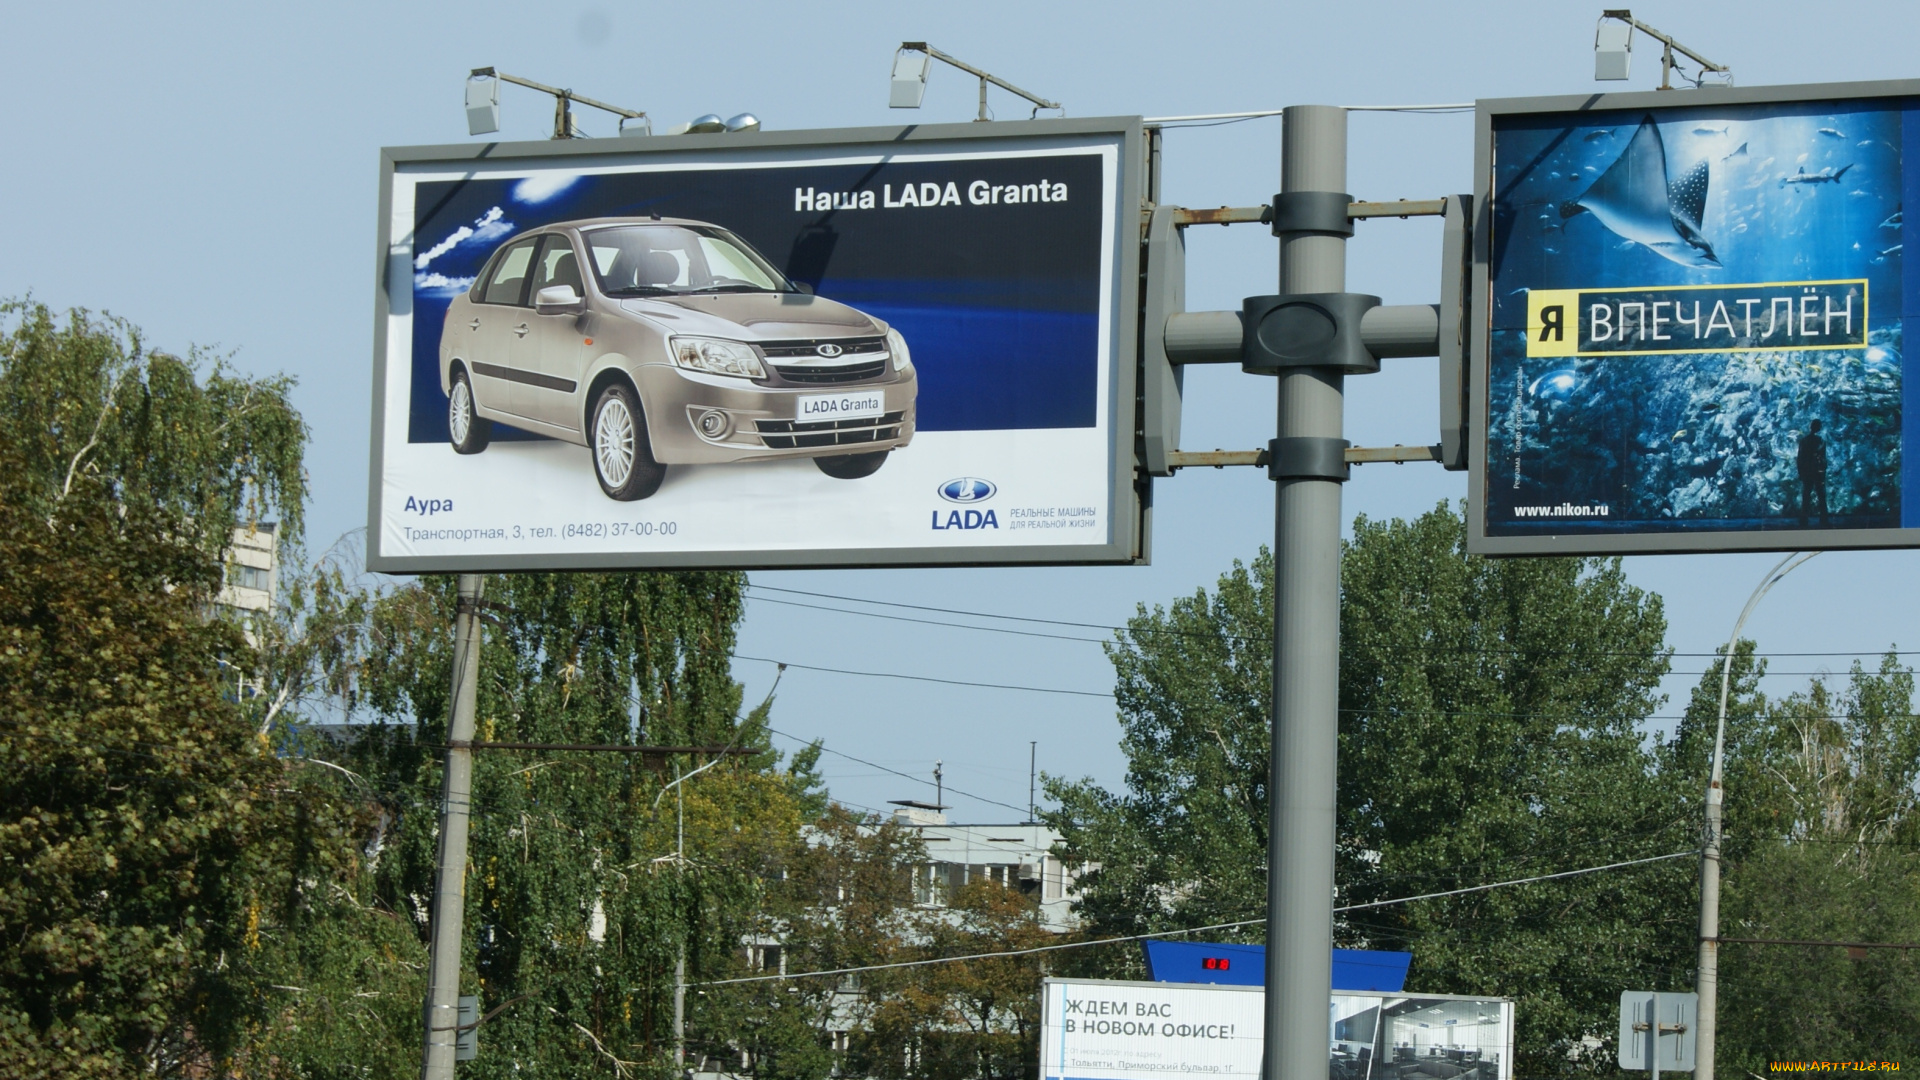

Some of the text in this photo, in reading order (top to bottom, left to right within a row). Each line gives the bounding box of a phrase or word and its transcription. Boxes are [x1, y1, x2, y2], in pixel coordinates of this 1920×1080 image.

[795, 179, 1068, 211] Наша LADA Granta
[1538, 287, 1851, 342] Я ВПЕЧАТЛЁН
[804, 398, 879, 414] LADA Granta
[404, 495, 454, 516] Аура
[1010, 507, 1096, 518] РЕАЛЬНЫЕ МАШИНЫ
[1514, 502, 1609, 517] www.nikon.ru
[931, 509, 999, 530] LADA
[1010, 519, 1096, 530] ДЛЯ РЕАЛЬНОЙ ЖИЗНИ
[404, 521, 678, 543] Транспортная, 3, тел. (8482) 37-00-00
[1065, 999, 1172, 1018] ЖДЕМ ВАС
[1065, 1019, 1235, 1039] В НОВОМ ОФИСЕ!
[1071, 1058, 1114, 1069] Тольятти,
[1119, 1060, 1178, 1071] Приморский
